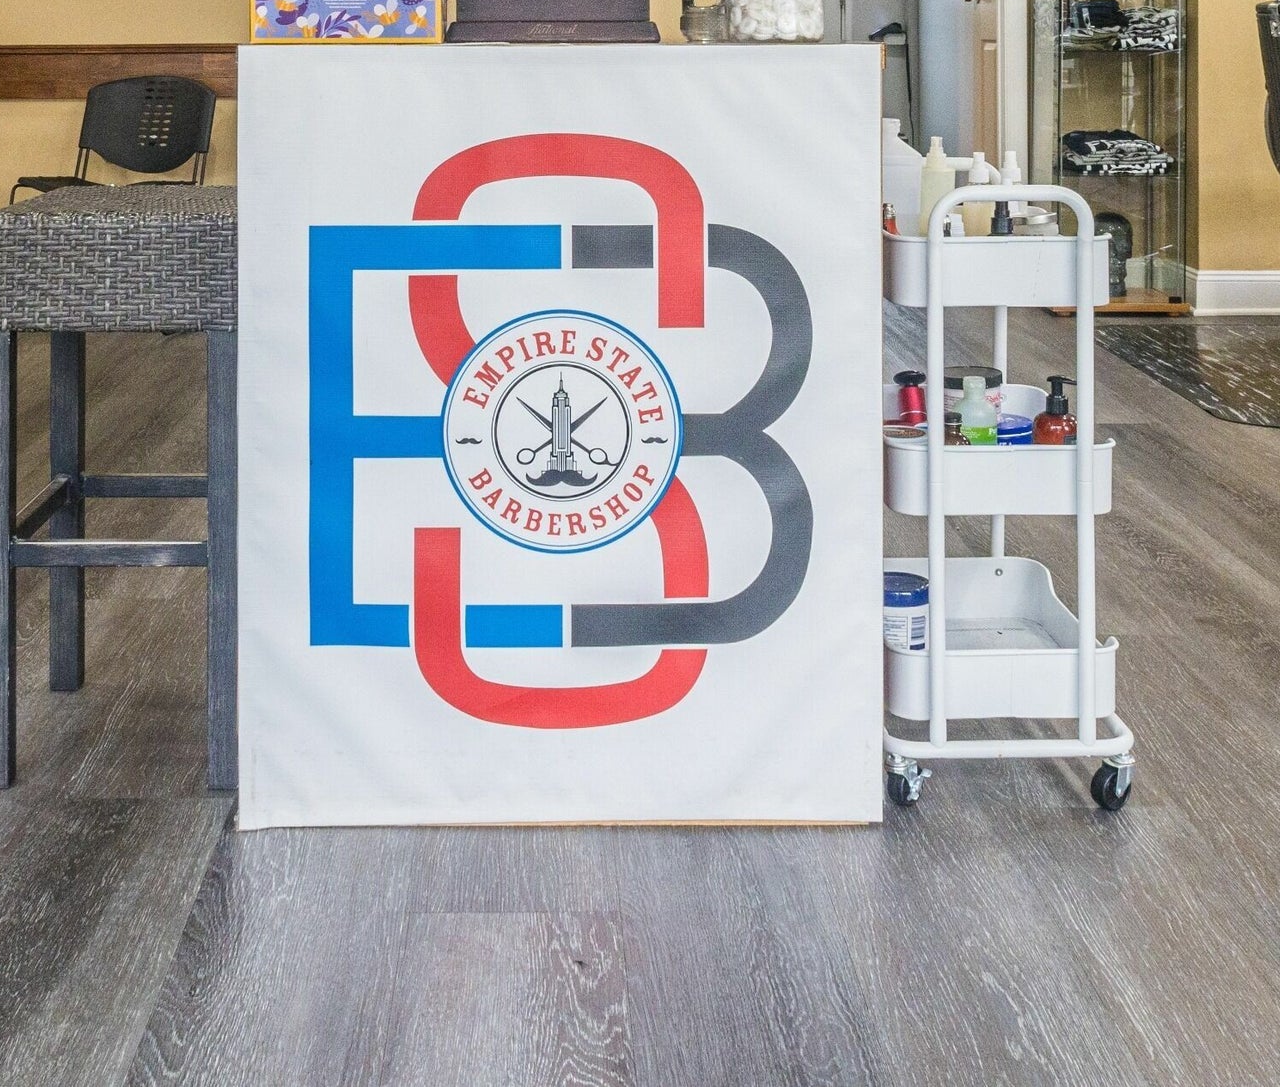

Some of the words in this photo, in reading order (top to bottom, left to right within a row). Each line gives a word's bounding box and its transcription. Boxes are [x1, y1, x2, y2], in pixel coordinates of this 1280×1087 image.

[463, 330, 576, 409] EMPIRE
[586, 337, 663, 424] STATE
[469, 464, 655, 536] BARBERSHOP
